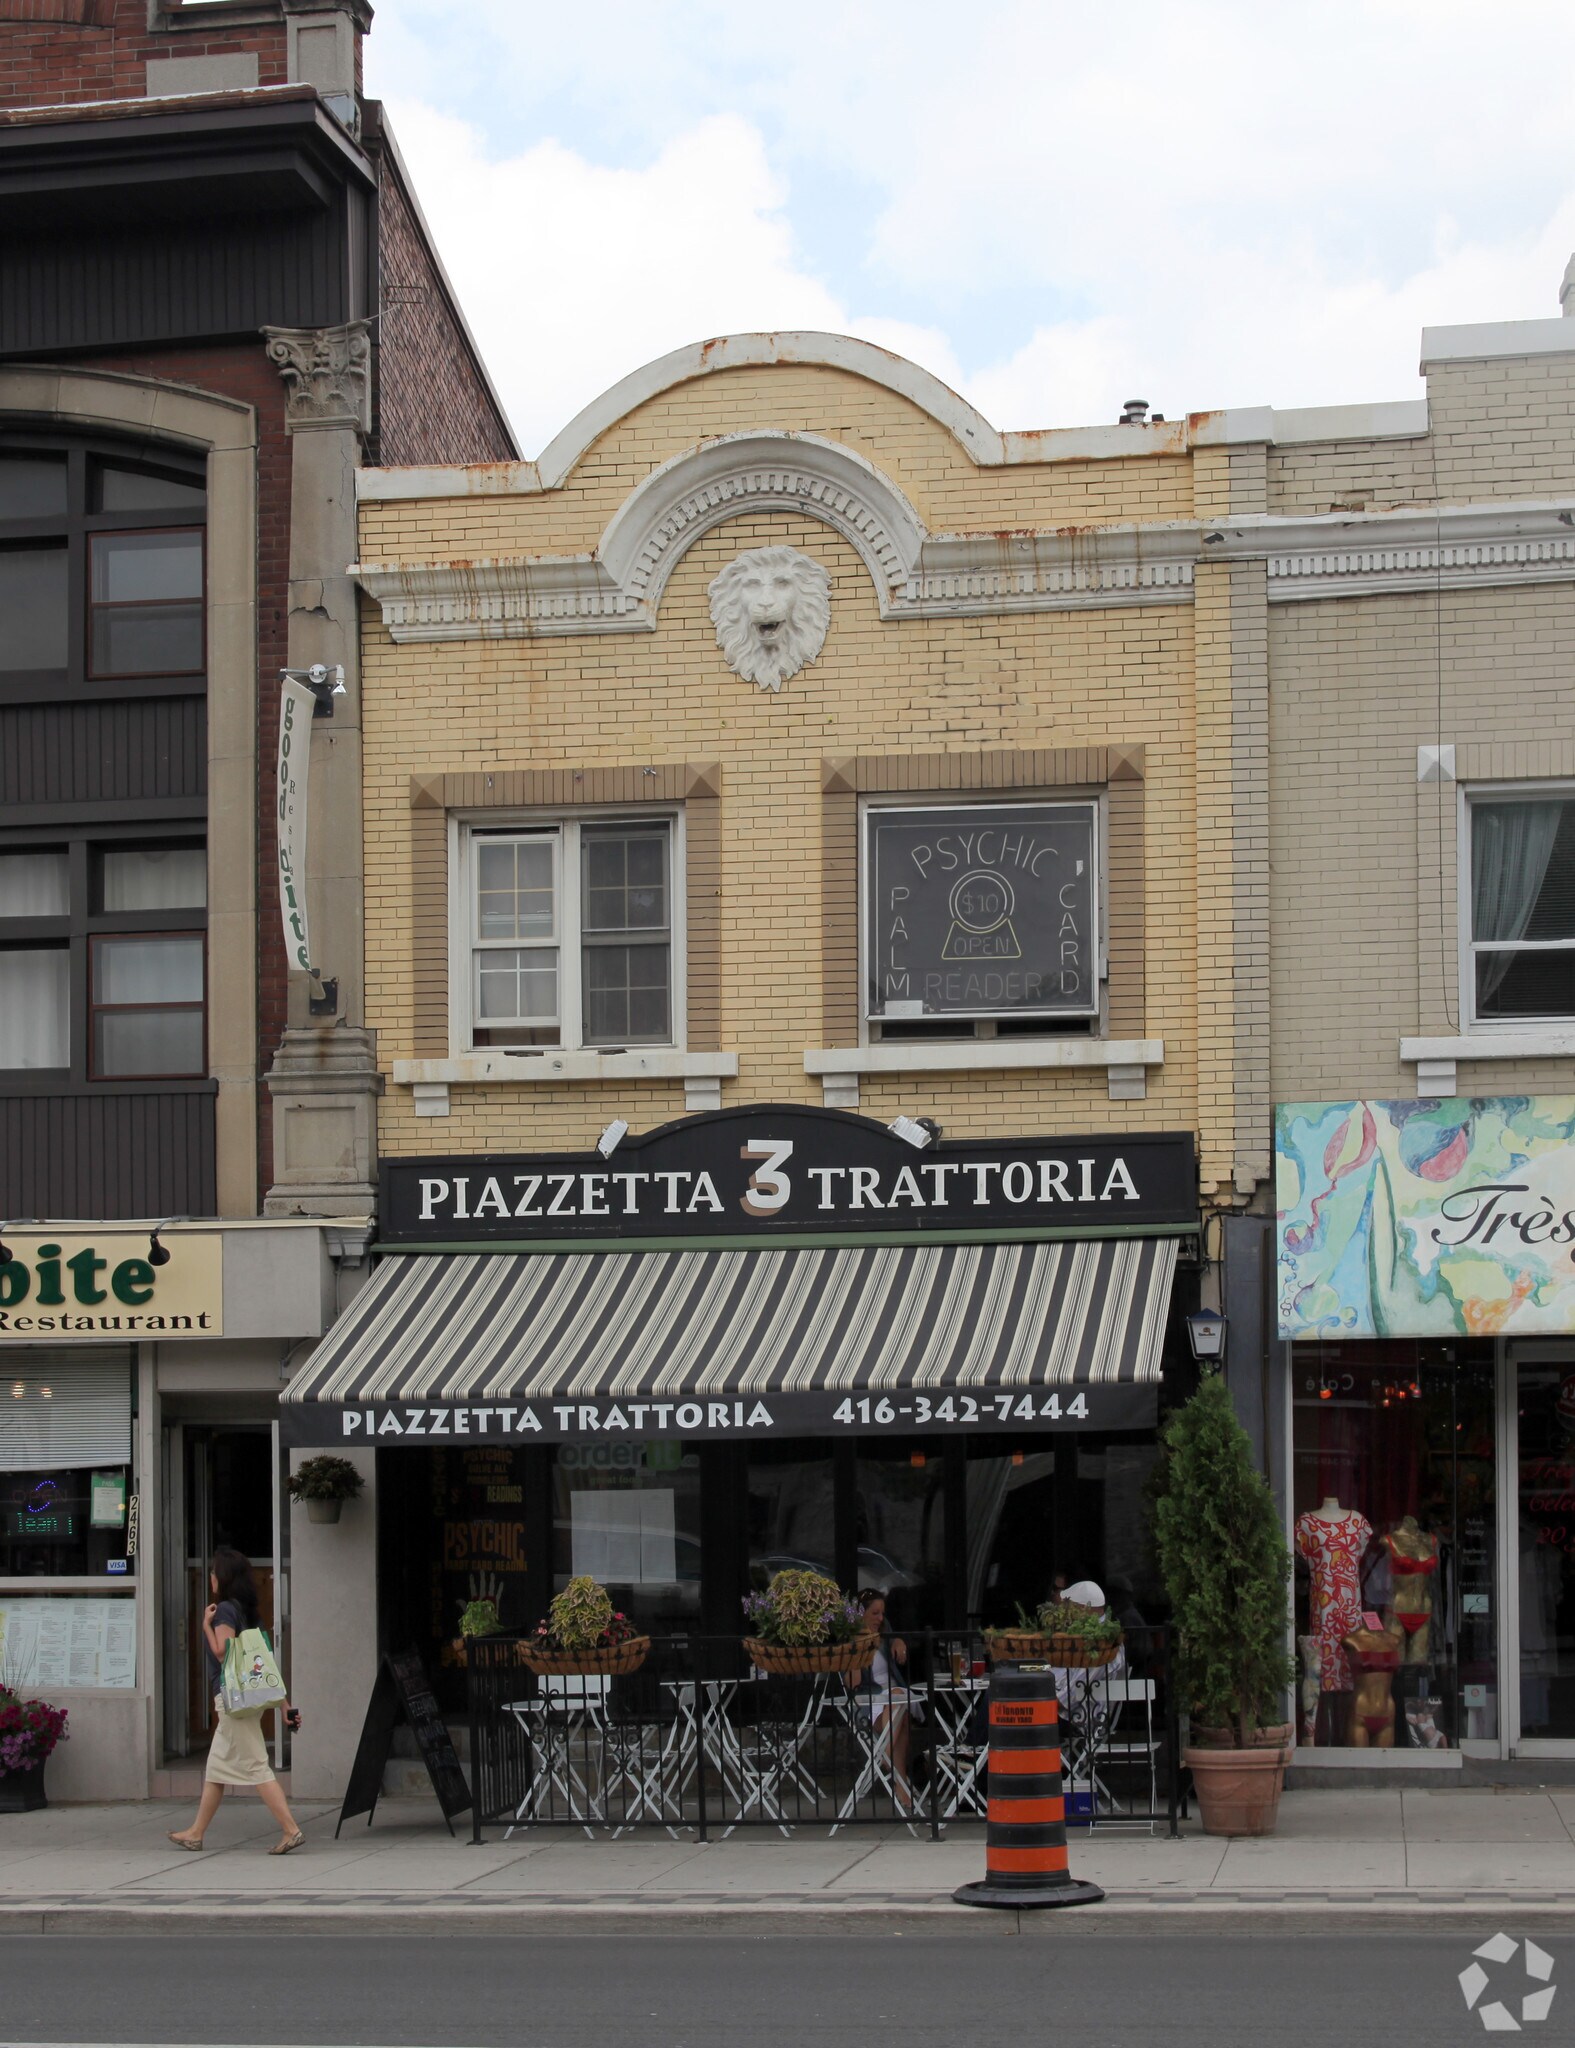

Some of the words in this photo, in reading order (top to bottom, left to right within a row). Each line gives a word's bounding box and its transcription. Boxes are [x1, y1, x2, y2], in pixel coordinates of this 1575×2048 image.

[278, 697, 295, 821] good
[911, 831, 1058, 878] PSYCHIC
[279, 839, 312, 973] bite
[962, 891, 998, 915] $10
[886, 887, 910, 997] PALM
[954, 936, 1009, 956] OPEN
[1058, 883, 1079, 994] CARD
[925, 972, 1042, 1000] READER
[418, 1171, 725, 1220] PIAZZETTA
[740, 1139, 793, 1216] 3
[807, 1157, 1141, 1210] TRATTORIA
[342, 1406, 543, 1436] PIAZZETTA
[553, 1400, 774, 1431] TRATTORIA
[832, 1392, 1090, 1424] 416-342-7444
[487, 1485, 523, 1503] READINGS
[128, 1496, 139, 1555] 2463
[444, 1521, 525, 1569] PSYCHIC
[109, 1561, 126, 1569] VISA
